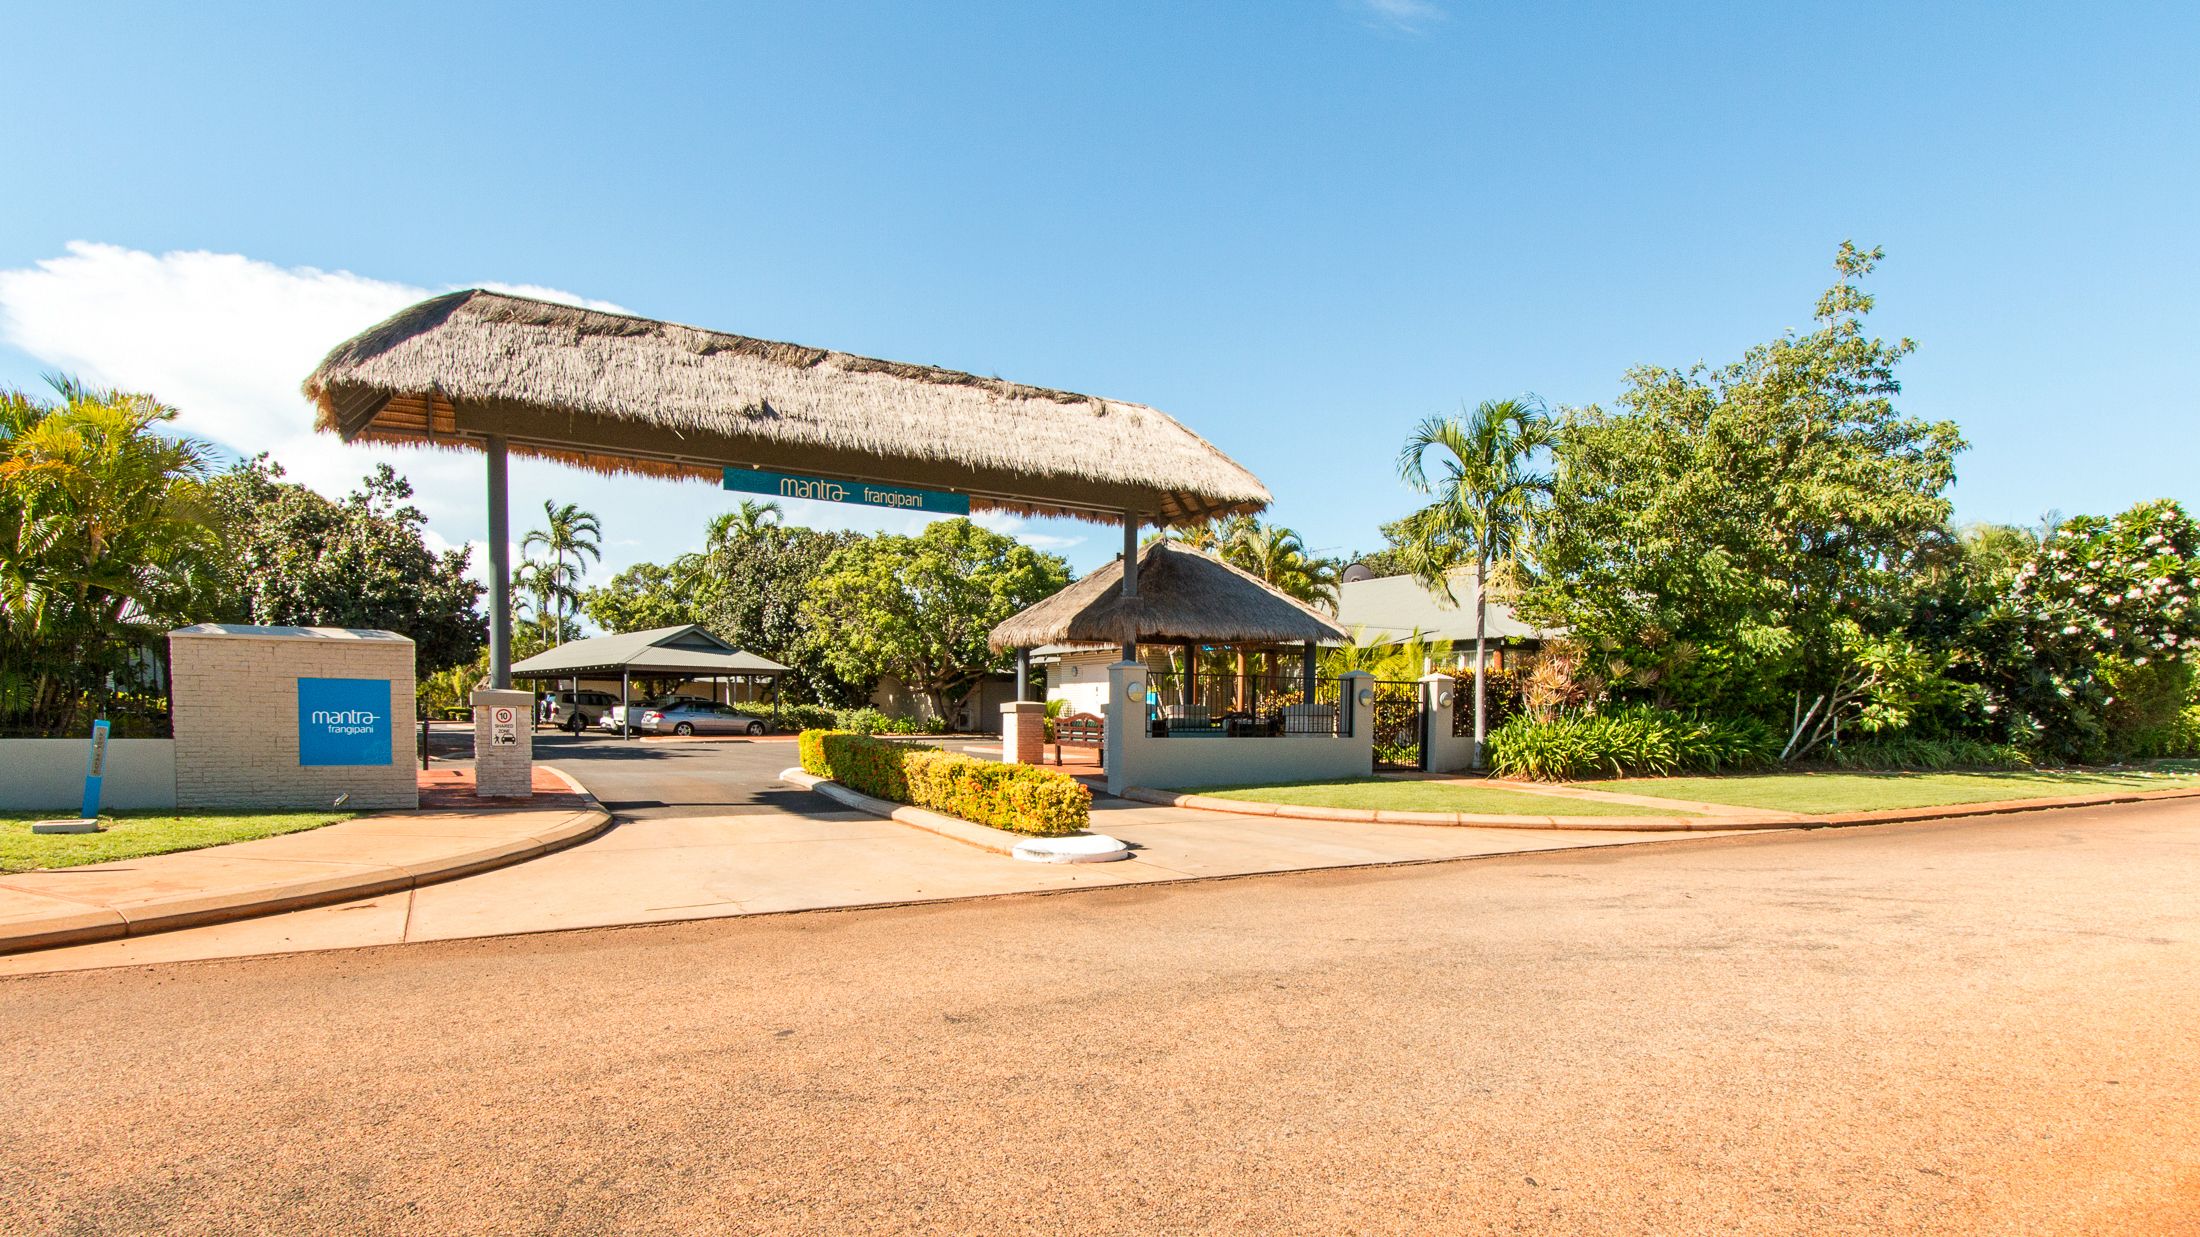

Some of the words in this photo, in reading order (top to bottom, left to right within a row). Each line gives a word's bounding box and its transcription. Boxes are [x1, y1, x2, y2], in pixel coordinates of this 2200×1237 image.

[780, 478, 850, 502] mantra
[863, 487, 923, 508] frangipani
[312, 709, 381, 724] mantra
[499, 712, 508, 720] 10
[328, 725, 374, 735] frangipani
